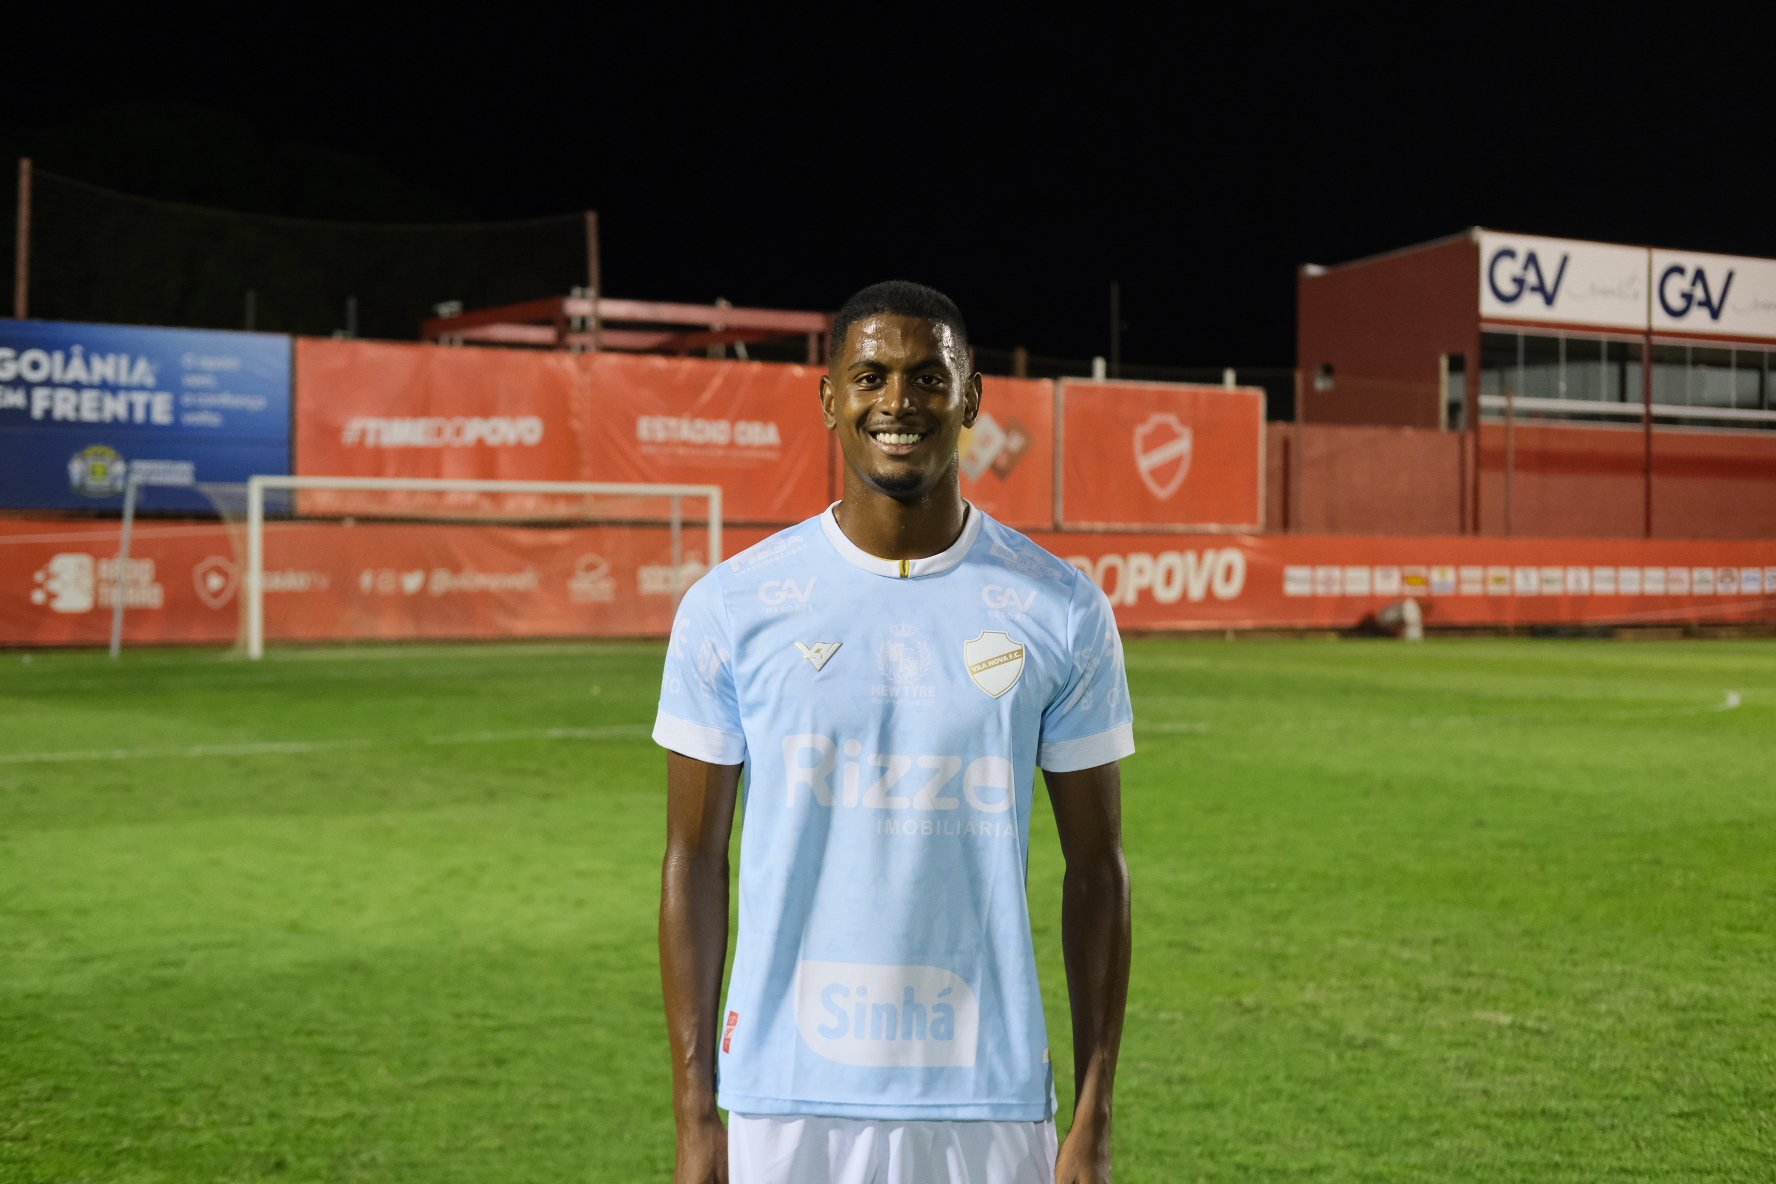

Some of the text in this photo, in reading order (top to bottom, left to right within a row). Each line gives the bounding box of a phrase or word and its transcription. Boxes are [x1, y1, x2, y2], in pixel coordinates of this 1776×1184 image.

[1488, 248, 1569, 307] GAV
[1658, 265, 1734, 321] GAV
[0, 345, 156, 387] GOIÂNIA
[31, 387, 173, 425] FRENTE
[758, 576, 818, 606] GAV
[981, 584, 1039, 612] GAV
[988, 655, 1009, 667] NOVA
[872, 684, 936, 698] NEW TYRE
[817, 982, 956, 1041] Sinhá
